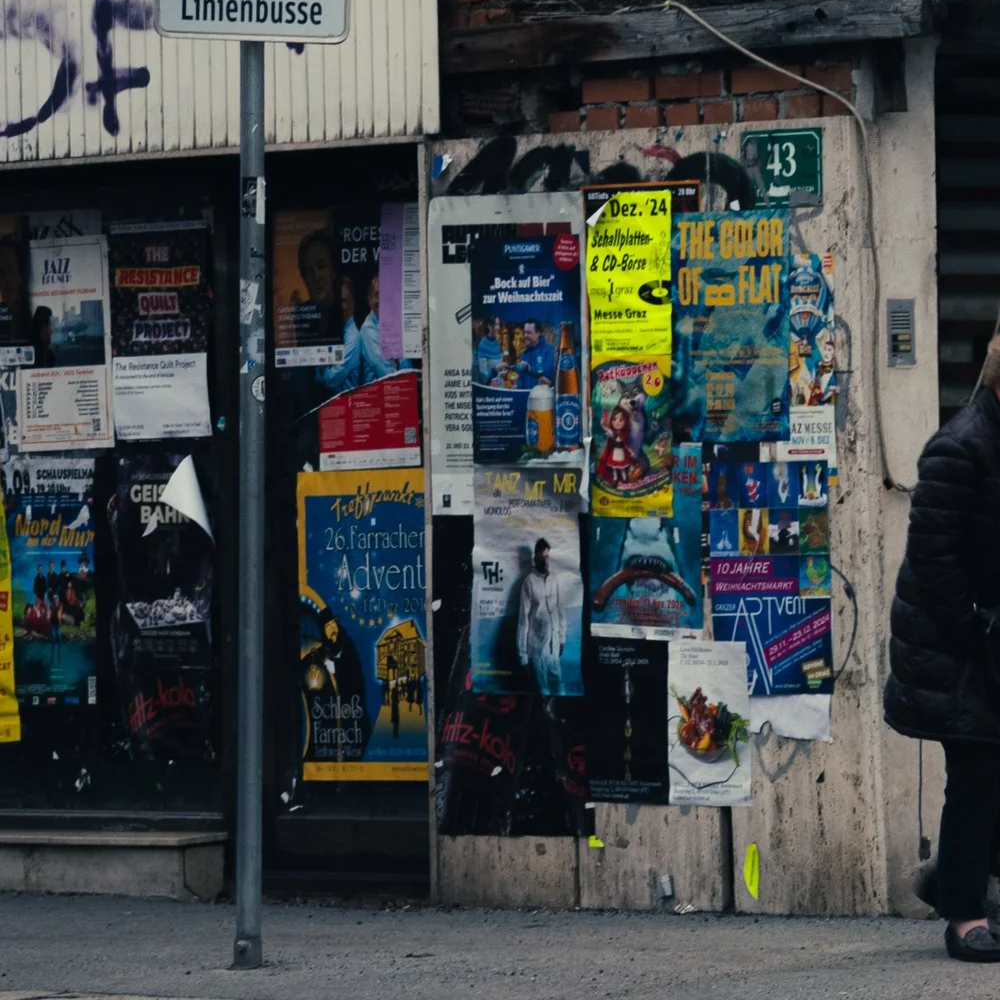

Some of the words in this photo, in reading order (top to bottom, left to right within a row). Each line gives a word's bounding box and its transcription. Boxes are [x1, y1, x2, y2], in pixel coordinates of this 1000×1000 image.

[766, 141, 797, 178] 43
[609, 199, 643, 218] Dez.
[646, 198, 668, 216] '24
[592, 228, 652, 251] Schallplatten-
[677, 220, 715, 260] THE
[719, 218, 784, 259] COLOR
[145, 246, 170, 262] THE
[341, 247, 368, 264] DER
[590, 259, 598, 272] &
[602, 253, 647, 272] CD-Börse
[44, 258, 70, 275] JAZZ
[119, 267, 198, 285] RESISTANCE
[518, 276, 532, 288] auf
[678, 265, 702, 306] OF
[738, 264, 783, 305] FLAT
[140, 295, 177, 313] QUILT
[482, 294, 497, 304] zur
[497, 289, 564, 304] Weihnachtszeit
[594, 309, 623, 320] Messe
[625, 308, 647, 319] Graz
[135, 321, 190, 339] PROJECT
[128, 362, 158, 371] Resistance
[175, 360, 196, 370] Project
[646, 374, 661, 387] 2.0
[445, 413, 469, 421] PATRICK
[804, 422, 833, 434] MESSE
[486, 471, 521, 494] TANZ
[524, 480, 547, 500] MIT
[553, 472, 577, 494] MIR
[330, 481, 415, 523] Treffpunkt
[140, 504, 190, 525] BAHN
[15, 512, 62, 537] Mord
[337, 551, 426, 591] Advent
[716, 562, 730, 575] 10
[730, 561, 770, 575] JAHRE
[715, 580, 794, 592] WEIHNACHTSMARKT
[311, 694, 364, 720] Schloß
[313, 720, 363, 744] Farrach
